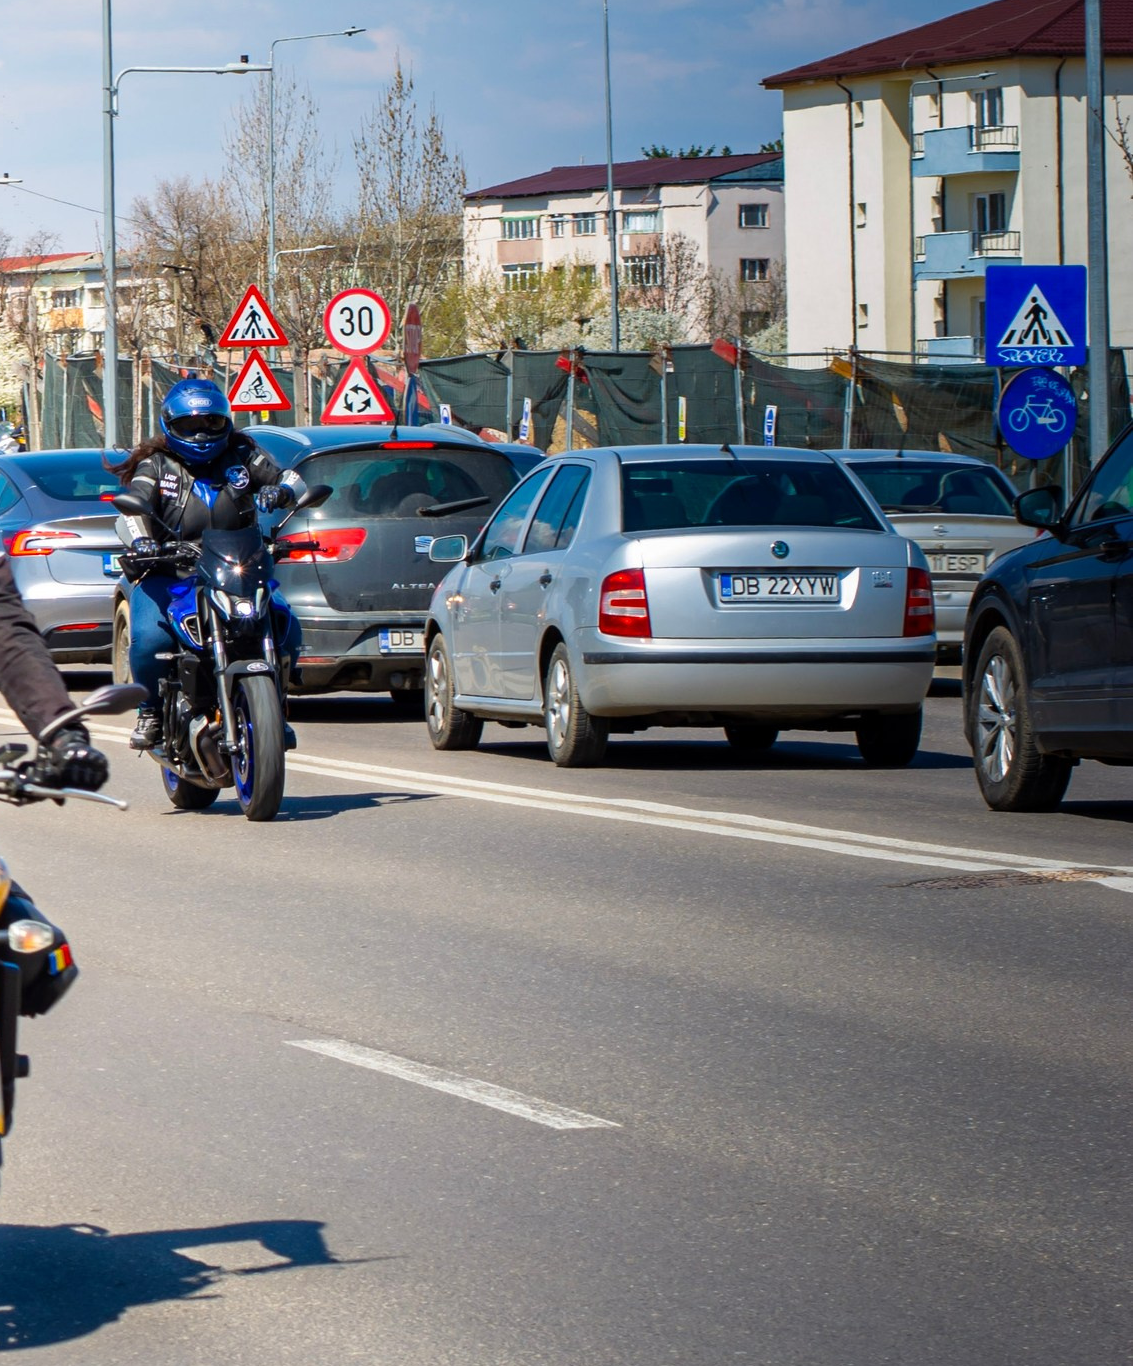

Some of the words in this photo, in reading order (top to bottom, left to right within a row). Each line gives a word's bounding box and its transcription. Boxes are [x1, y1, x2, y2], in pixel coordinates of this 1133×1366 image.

[339, 306, 374, 337] 30
[190, 398, 211, 406] SHOEI
[160, 480, 178, 490] MARY
[164, 473, 178, 482] LADY
[947, 556, 979, 571] ESP
[732, 577, 760, 596] DB
[768, 576, 834, 596] 22XYW
[390, 630, 415, 647] DB
